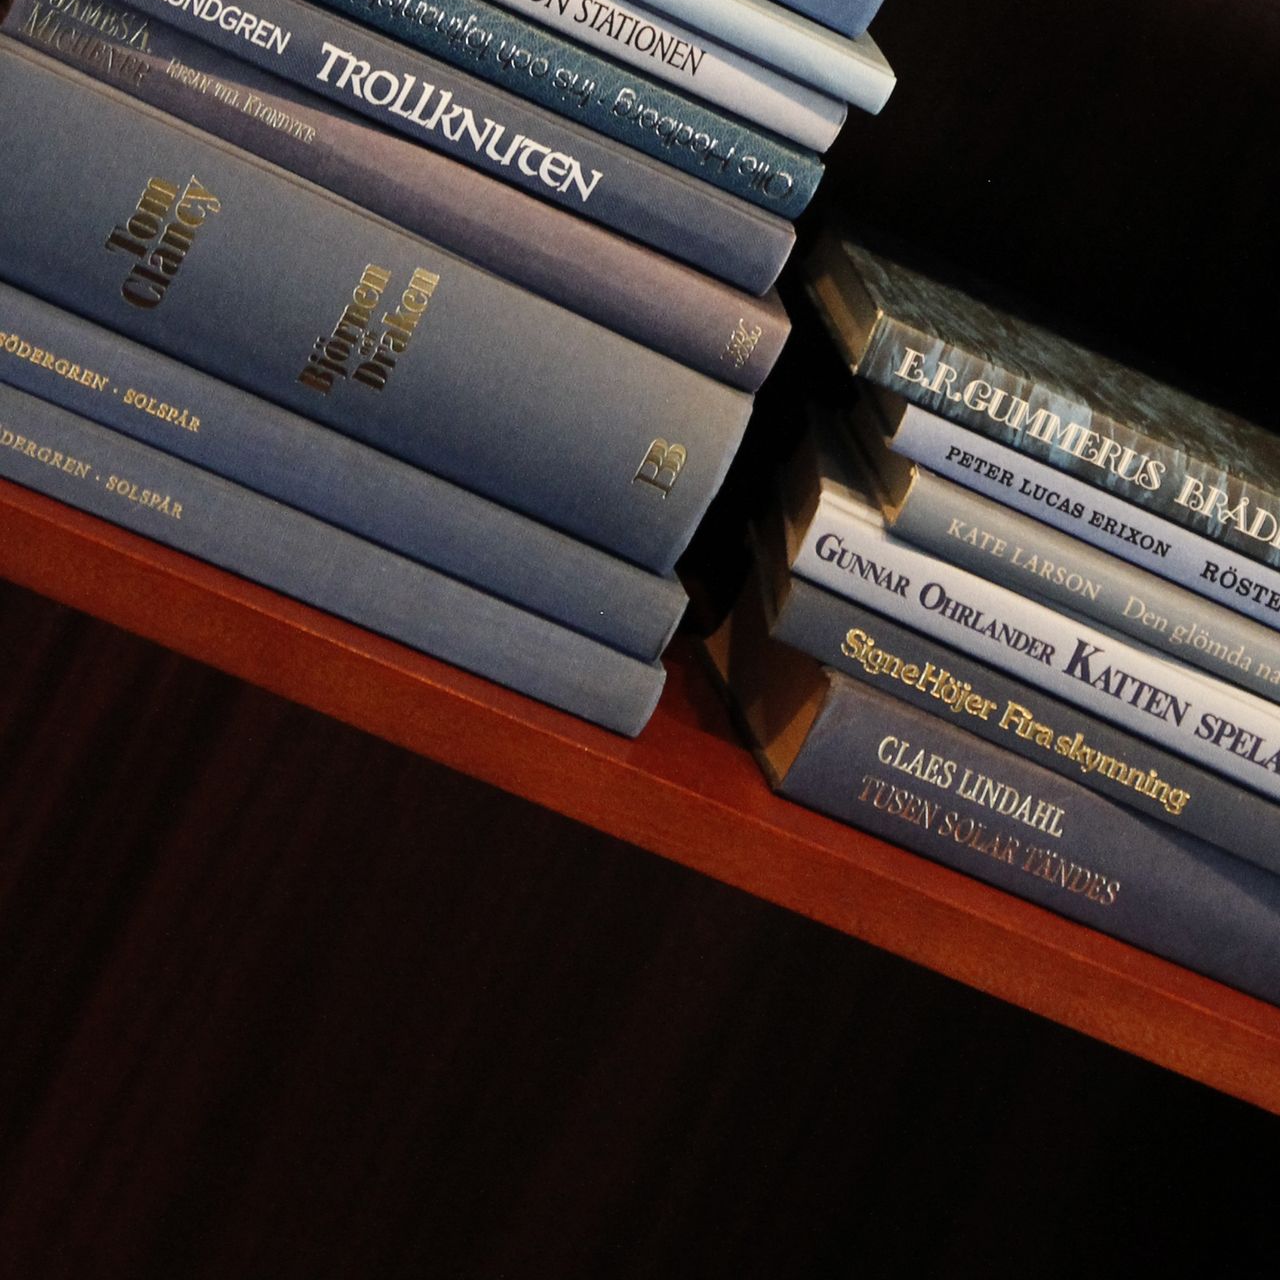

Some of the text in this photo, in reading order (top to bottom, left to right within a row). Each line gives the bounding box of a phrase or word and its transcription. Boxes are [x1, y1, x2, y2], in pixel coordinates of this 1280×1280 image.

[18, 0, 152, 87] MICHENER
[499, 38, 549, 79] och
[551, 67, 597, 109] Iris
[166, 55, 318, 145] RESAN TILL KLONDYKE
[315, 40, 603, 204] TROLLKNUTEN
[614, 86, 794, 202] Olle Hedberg
[104, 176, 178, 260] Tom
[120, 174, 222, 310] Clancy
[295, 263, 392, 395] Björnen
[351, 267, 441, 392] Draken
[0, 332, 201, 433] SÖDERGREN SOLSPÅR
[0, 425, 184, 520] DERGREN SOLSPÅR
[945, 445, 1172, 558] PETER LUCAS ERIXON
[815, 533, 1057, 666] GUNNAR OHRLANDER
[946, 518, 1103, 601] KATE LARSON
[1121, 595, 1169, 632] Den
[1169, 620, 1251, 673] glömda
[1061, 639, 1193, 728] KATTEN
[876, 734, 1065, 838] CLAES LINDAHL
[1054, 732, 1191, 816] skymning
[857, 774, 1121, 906] TUSEN SOLAR TÄNDES
